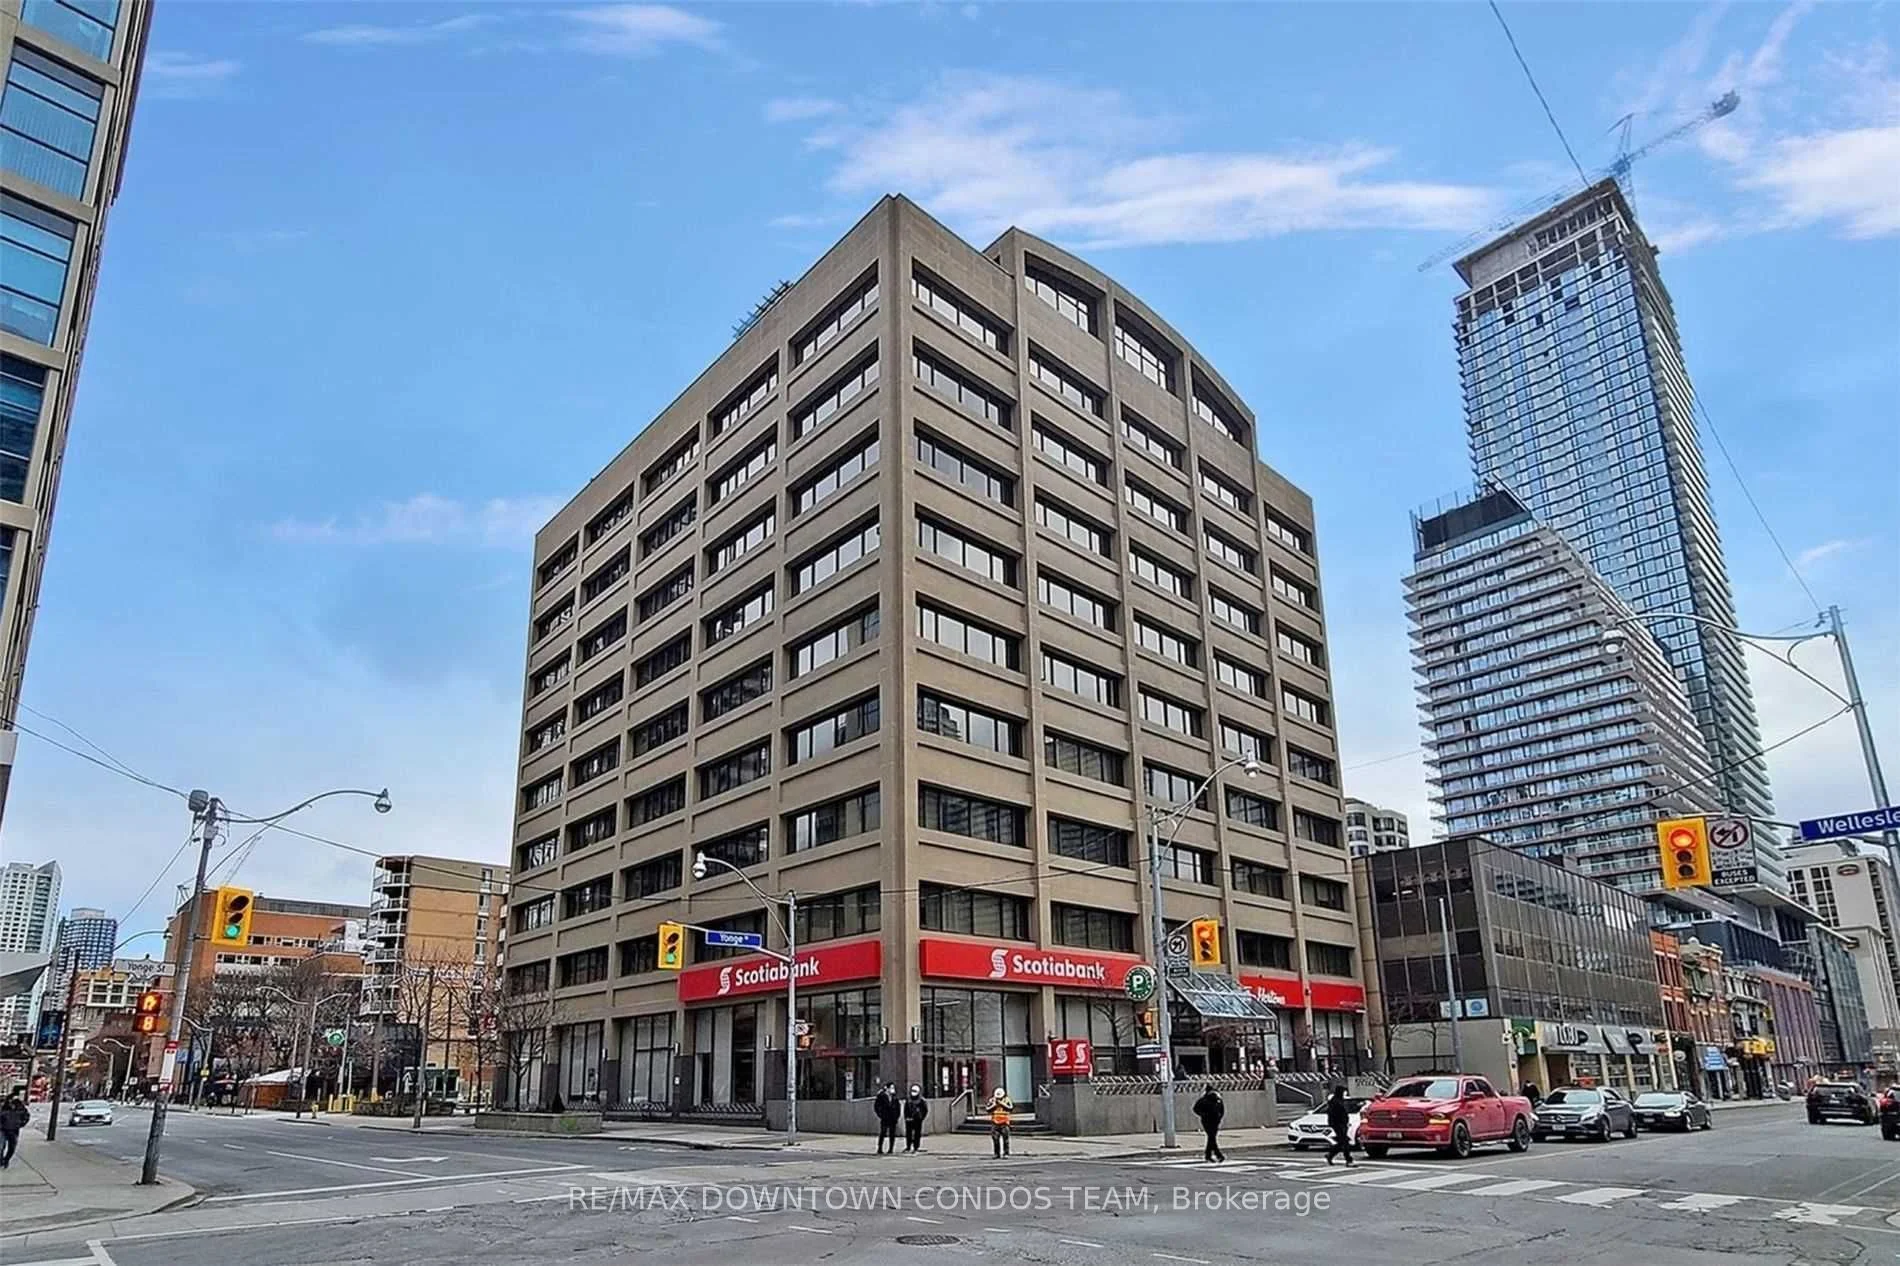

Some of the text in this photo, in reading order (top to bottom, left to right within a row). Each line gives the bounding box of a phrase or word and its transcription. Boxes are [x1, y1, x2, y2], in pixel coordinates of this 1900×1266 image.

[1721, 868, 1748, 878] BUSES
[1714, 875, 1756, 885] EXCEPTED
[720, 934, 744, 946] Yonge
[735, 956, 820, 986] Scotiabank
[1012, 954, 1105, 980] Scotiabank
[1132, 975, 1144, 988] P
